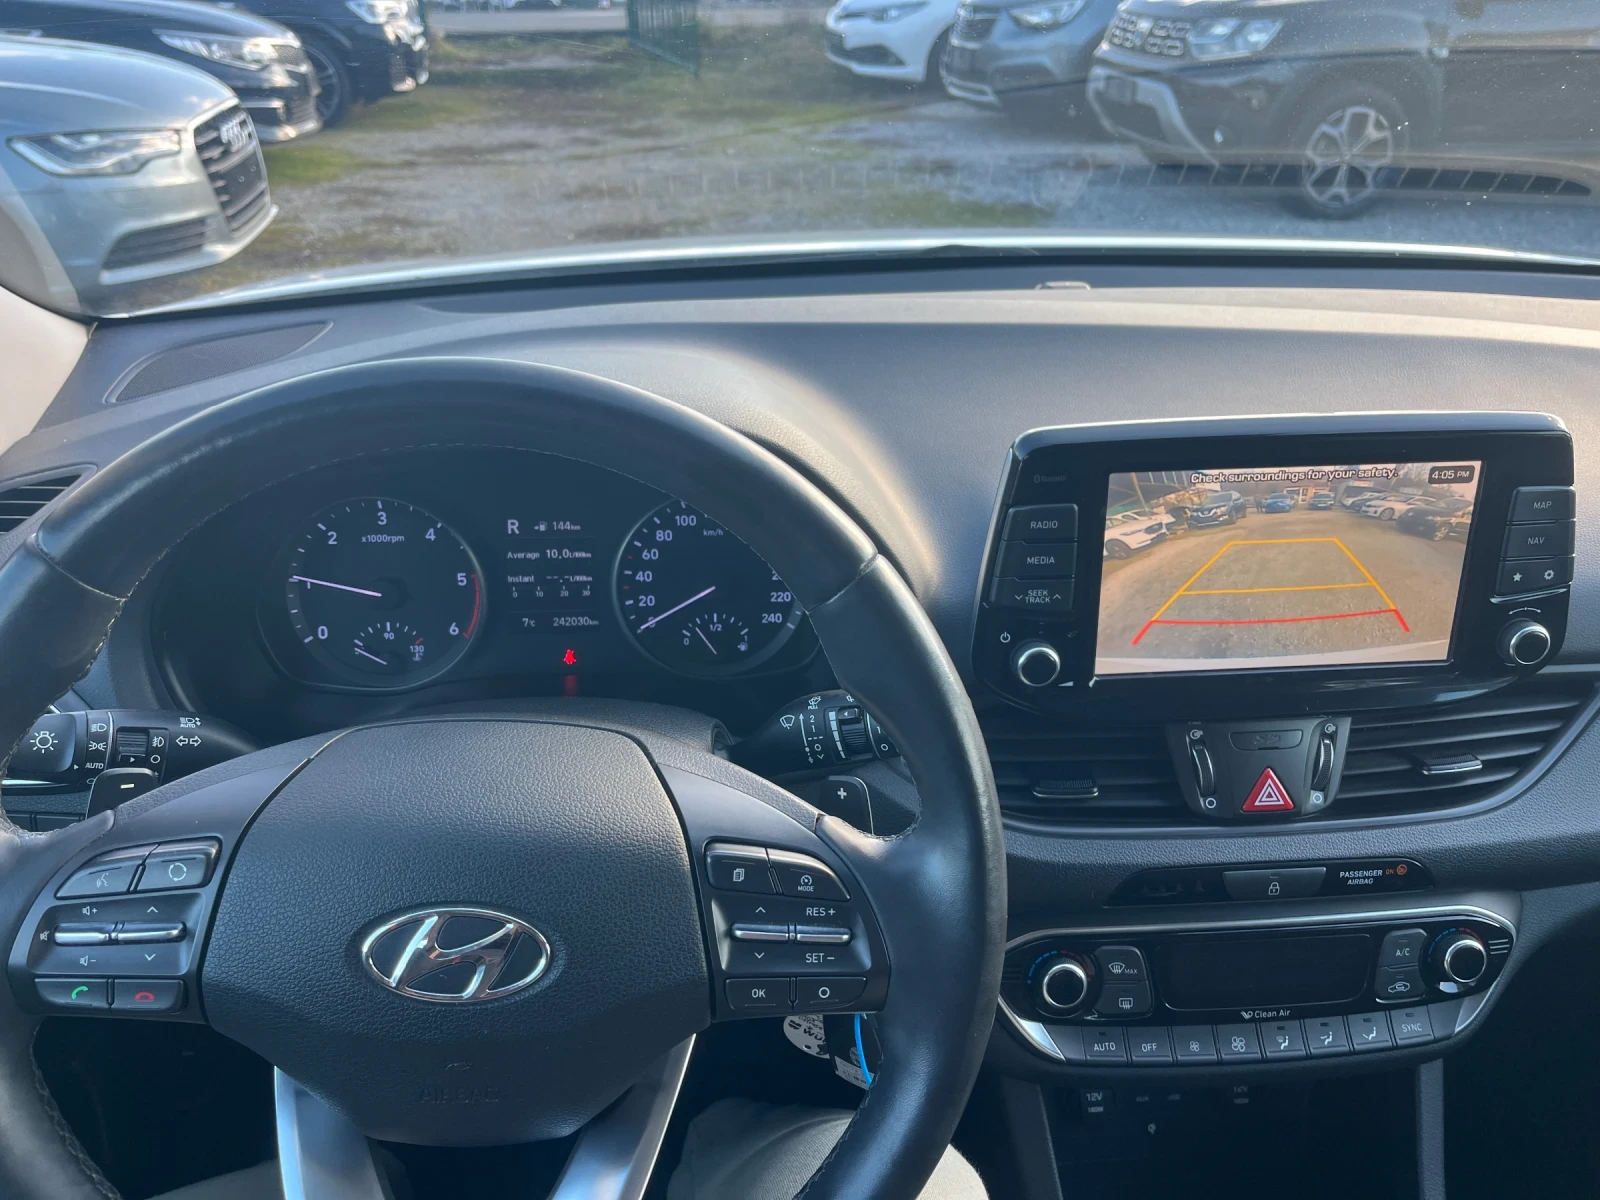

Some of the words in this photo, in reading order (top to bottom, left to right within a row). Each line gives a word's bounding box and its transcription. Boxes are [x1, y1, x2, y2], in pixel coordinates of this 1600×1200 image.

[1191, 472, 1227, 483] Check
[1228, 470, 1305, 483] surroundings
[1307, 470, 1326, 480] for
[1328, 469, 1355, 480] your
[1358, 467, 1399, 478] safety.
[1431, 470, 1455, 479] 4:05
[1533, 501, 1552, 509] MAP
[377, 511, 388, 525] 3
[675, 515, 697, 526] 100
[507, 519, 520, 534] R
[1030, 520, 1059, 530] RADIO
[425, 528, 436, 541] 4
[656, 530, 673, 541] 80
[703, 528, 724, 537] km/h
[327, 531, 338, 545] 2
[361, 534, 405, 543] x1000rpm
[1527, 537, 1545, 545] NAV
[507, 551, 541, 560] Average
[642, 549, 659, 560] 60
[1026, 556, 1055, 565] MEDIA
[457, 573, 467, 586] 5
[507, 575, 535, 583] Instant
[635, 570, 653, 582] 40
[638, 595, 655, 607] 20
[770, 591, 791, 602] 220
[761, 613, 783, 624] 240
[317, 625, 328, 640] 0
[449, 622, 459, 635] 6
[709, 624, 723, 632] 1/2
[383, 632, 395, 640] 90
[683, 637, 690, 646] 0
[809, 714, 815, 723] 2
[85, 762, 104, 770] AUTO
[1339, 869, 1383, 878] PASSENGER
[1395, 948, 1410, 957] A/C
[751, 988, 766, 998] OK
[1254, 1009, 1277, 1018] Clean
[1279, 1009, 1291, 1017] Air
[1401, 1023, 1423, 1032] SYNC
[1093, 1042, 1116, 1051] AUTO
[1141, 1042, 1158, 1052] OFF
[1086, 1092, 1103, 1101] 12V
